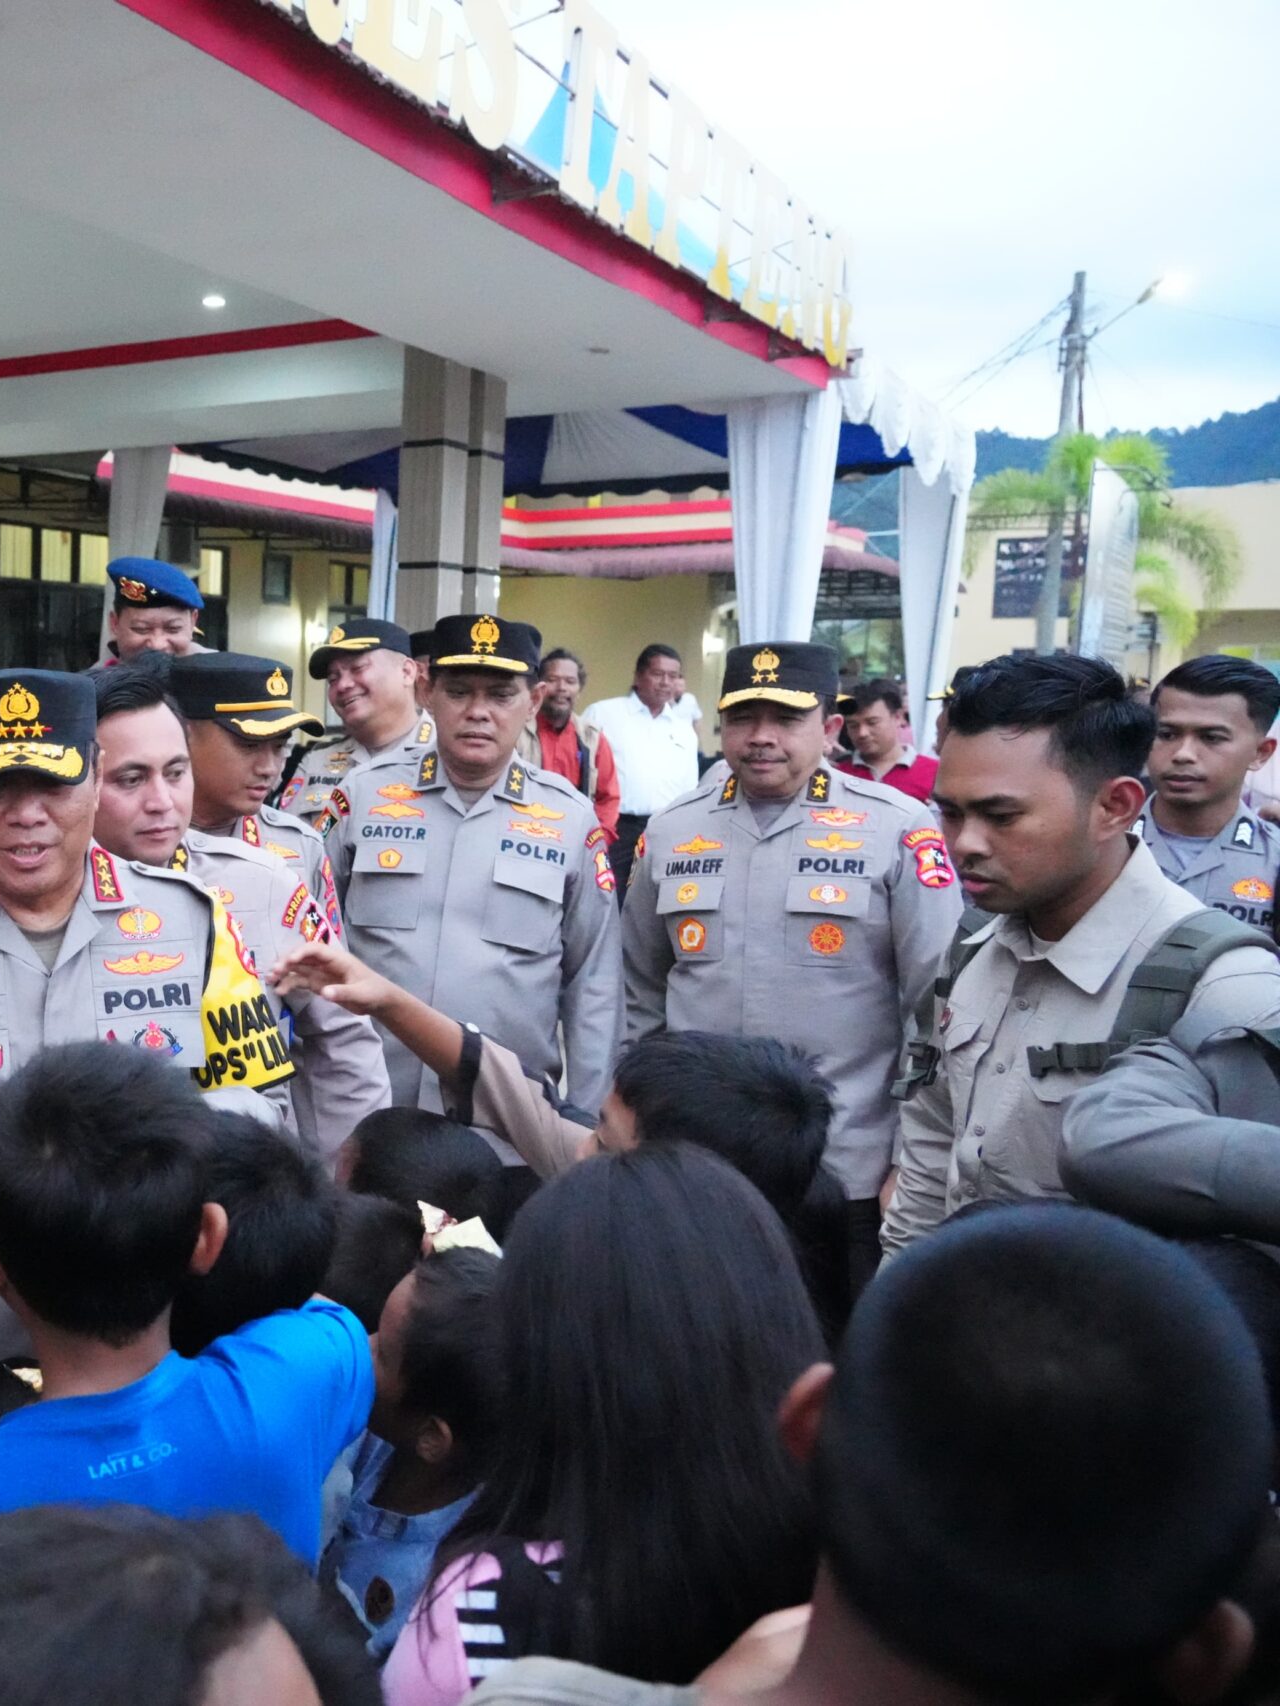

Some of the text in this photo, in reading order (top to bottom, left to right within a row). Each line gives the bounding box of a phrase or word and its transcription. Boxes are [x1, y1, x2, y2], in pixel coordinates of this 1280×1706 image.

[362, 825, 426, 840] GATOT.R
[501, 838, 565, 866] POLRI
[666, 857, 724, 877] UMAR EFF
[798, 857, 865, 875] POLRI
[104, 983, 191, 1014] POLRI
[88, 1456, 127, 1479] LATT
[132, 1454, 145, 1468] &
